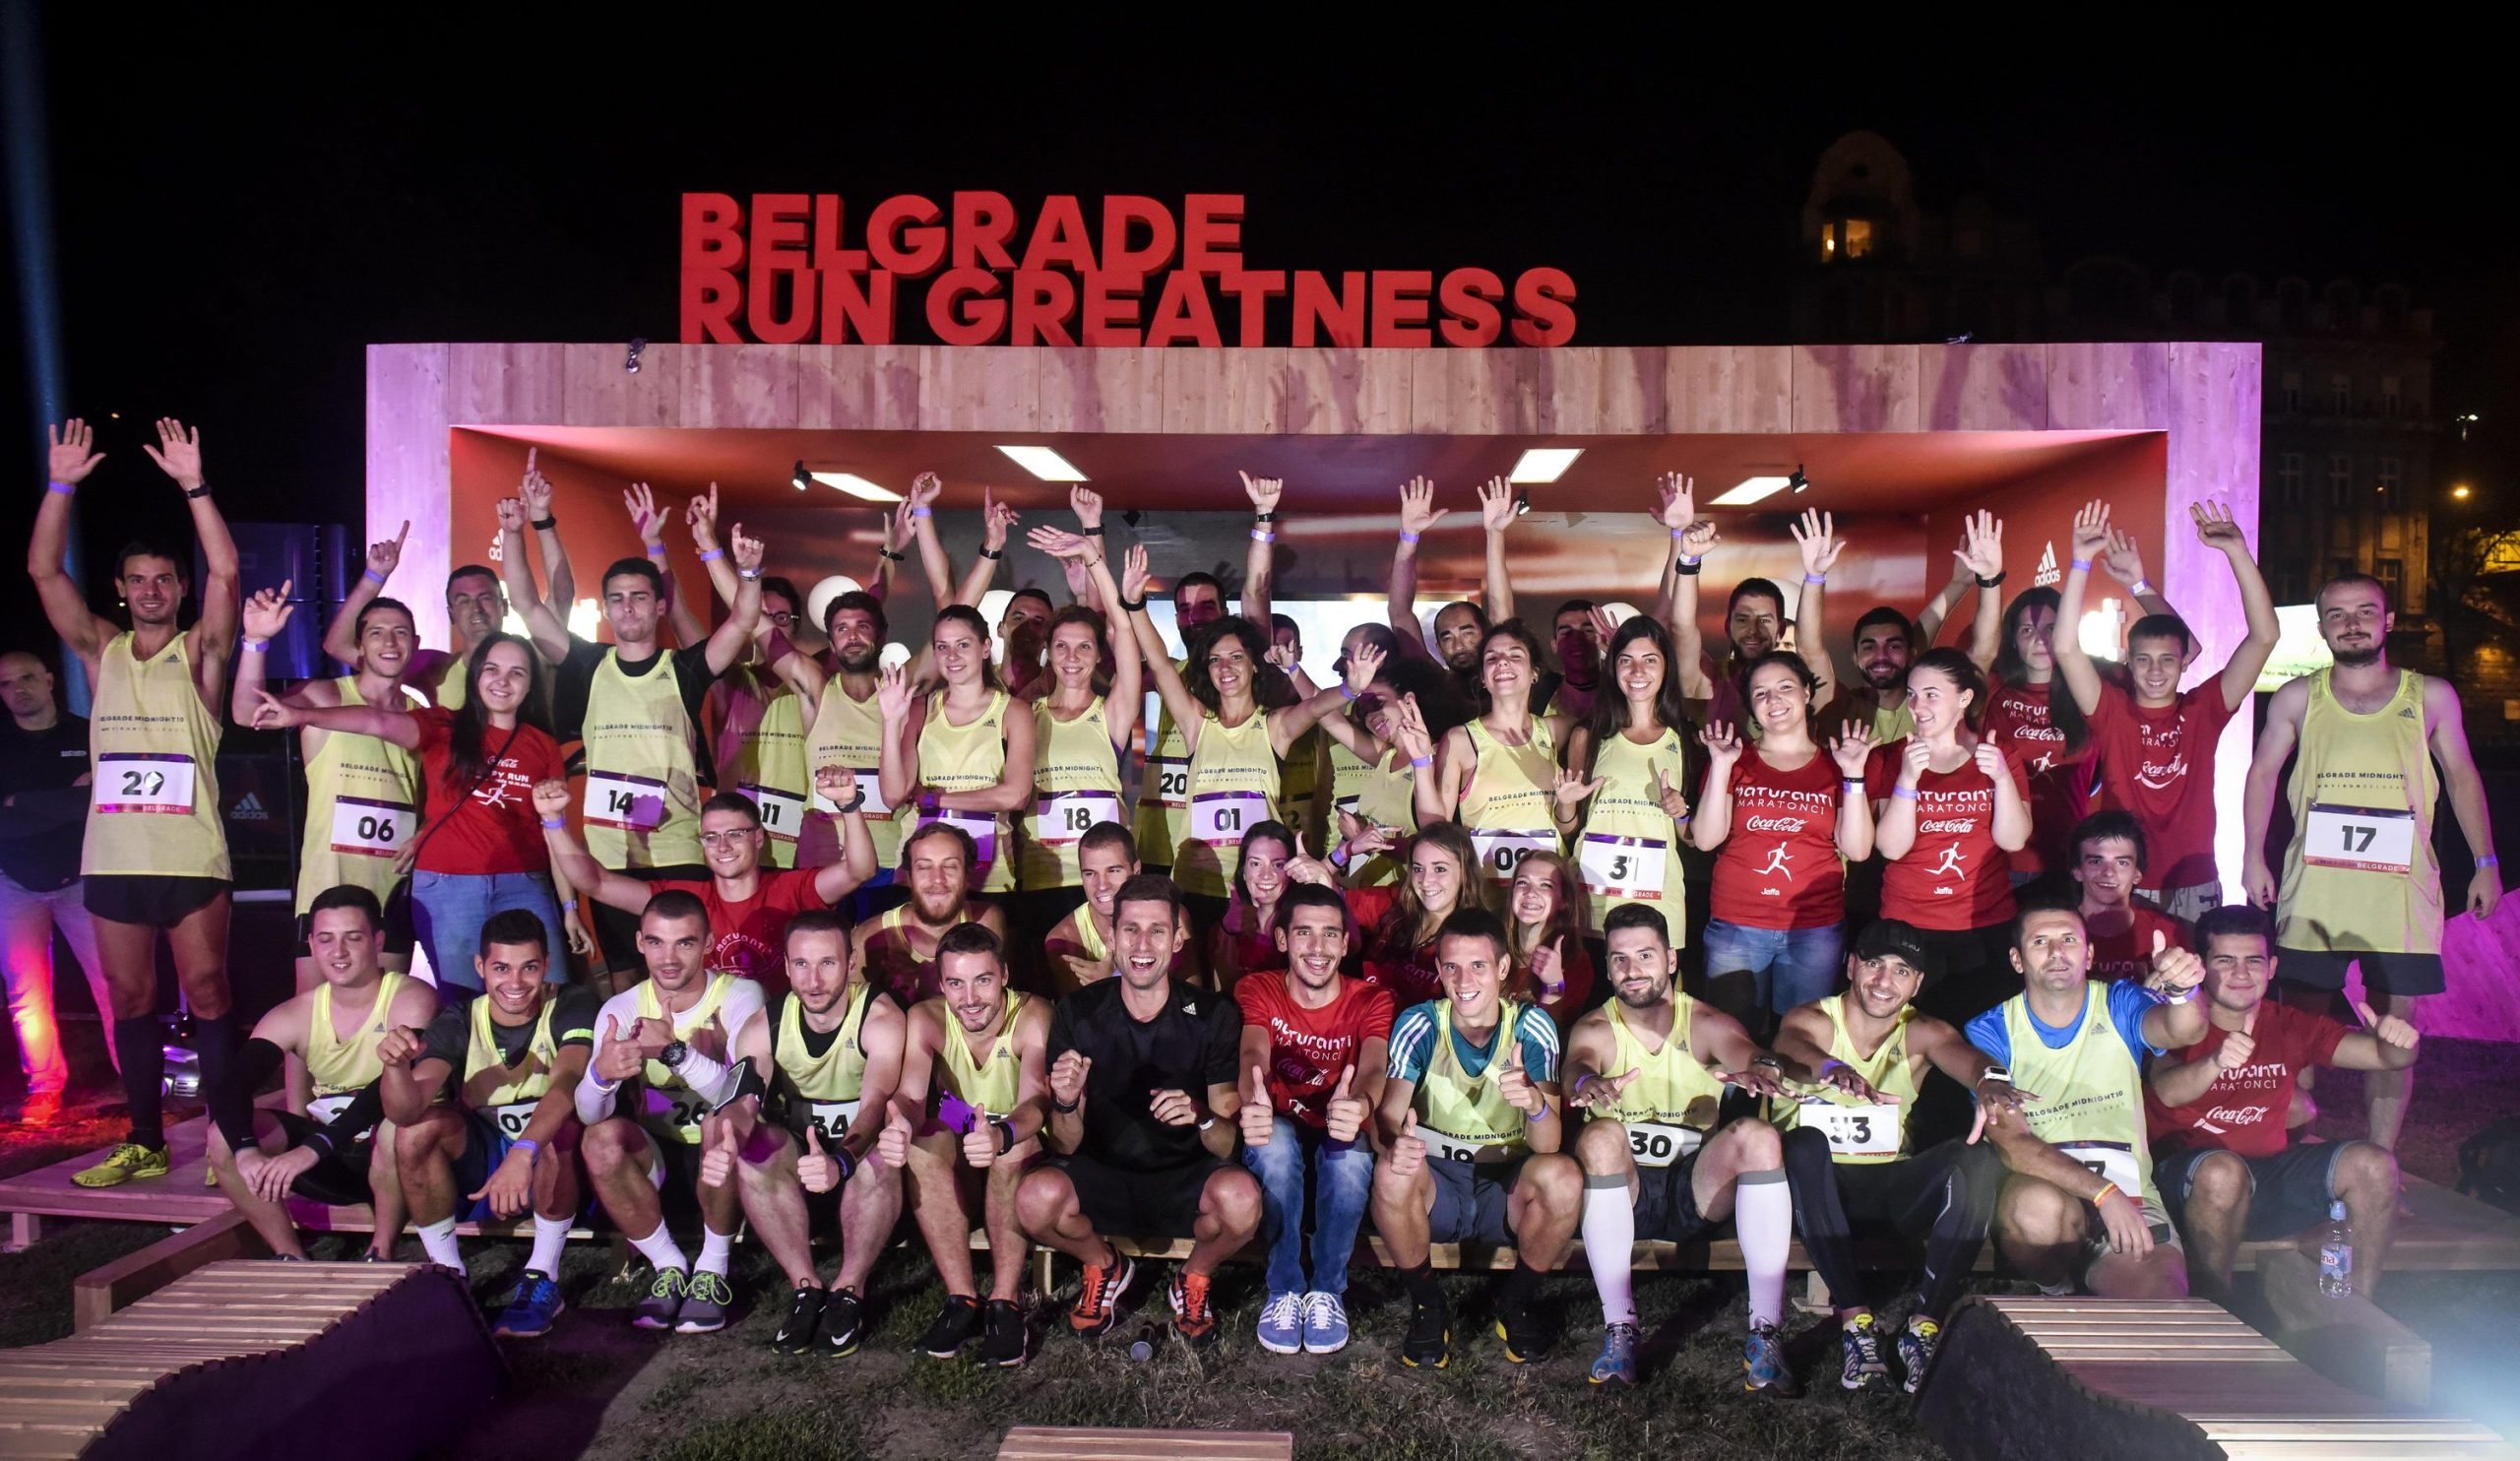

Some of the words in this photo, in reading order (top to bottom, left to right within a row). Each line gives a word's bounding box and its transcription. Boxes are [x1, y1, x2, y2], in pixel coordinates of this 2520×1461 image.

[681, 191, 1244, 276] BELGRADE
[680, 267, 897, 346] RUN
[925, 266, 1576, 348] GREATNESS
[2034, 568, 2061, 588] adidas
[2009, 710, 2051, 726] MARAT
[121, 770, 165, 796] 29
[507, 772, 530, 784] RUN
[1159, 772, 1188, 794] 20
[608, 790, 634, 815] 14
[1488, 791, 1529, 802] BELGRADE
[1736, 798, 1825, 815] MARATONCI
[1916, 802, 1992, 813] ARATONCI
[761, 801, 782, 826] 11
[1063, 806, 1093, 831] 18
[1214, 807, 1242, 832] 01
[1746, 814, 1809, 833] Coca-Cola
[357, 815, 395, 843] 06
[1920, 817, 1979, 834] Coca-Cola
[2341, 825, 2377, 853] 17
[2357, 862, 2399, 872] BELGRADE
[1760, 887, 1781, 897] Jaffa
[2210, 1079, 2278, 1092] ARATONCI
[671, 1101, 709, 1126] 26
[811, 1113, 850, 1137] 34
[1629, 1130, 1672, 1158] 30
